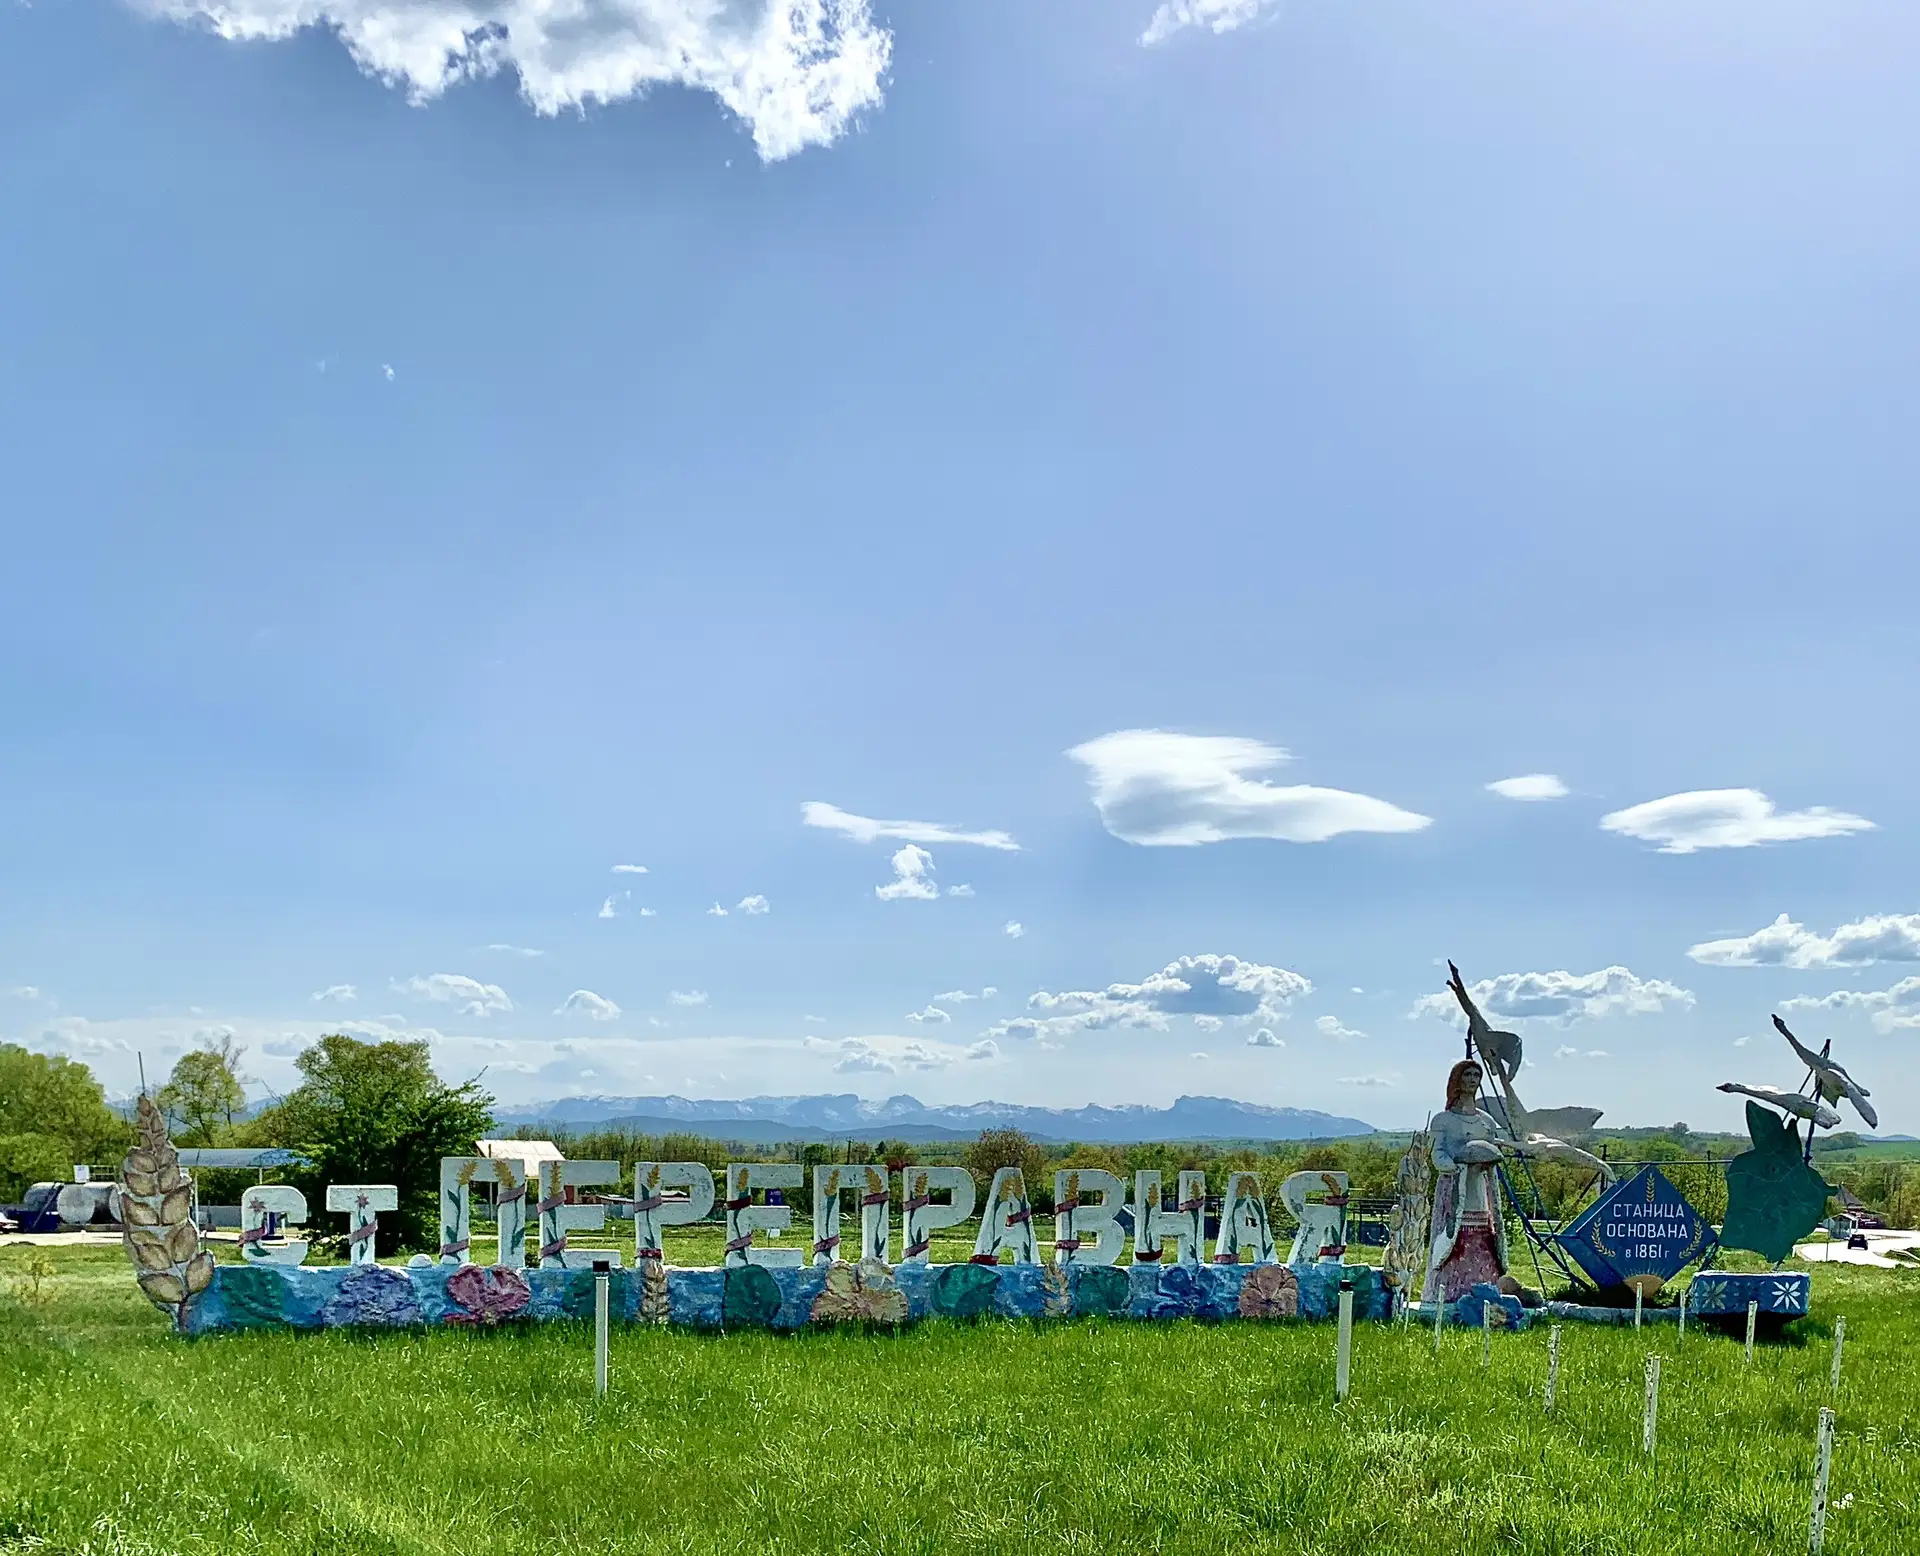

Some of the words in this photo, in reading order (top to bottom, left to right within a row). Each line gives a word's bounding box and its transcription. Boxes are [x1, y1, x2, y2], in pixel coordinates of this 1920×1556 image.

[439, 1157, 1349, 1268] ПЕРЕПРАВНАЯ
[1613, 1203, 1685, 1218] СТАНИЦА
[1606, 1223, 1688, 1239] ОСНОВАНА
[1635, 1244, 1662, 1258] 1861
